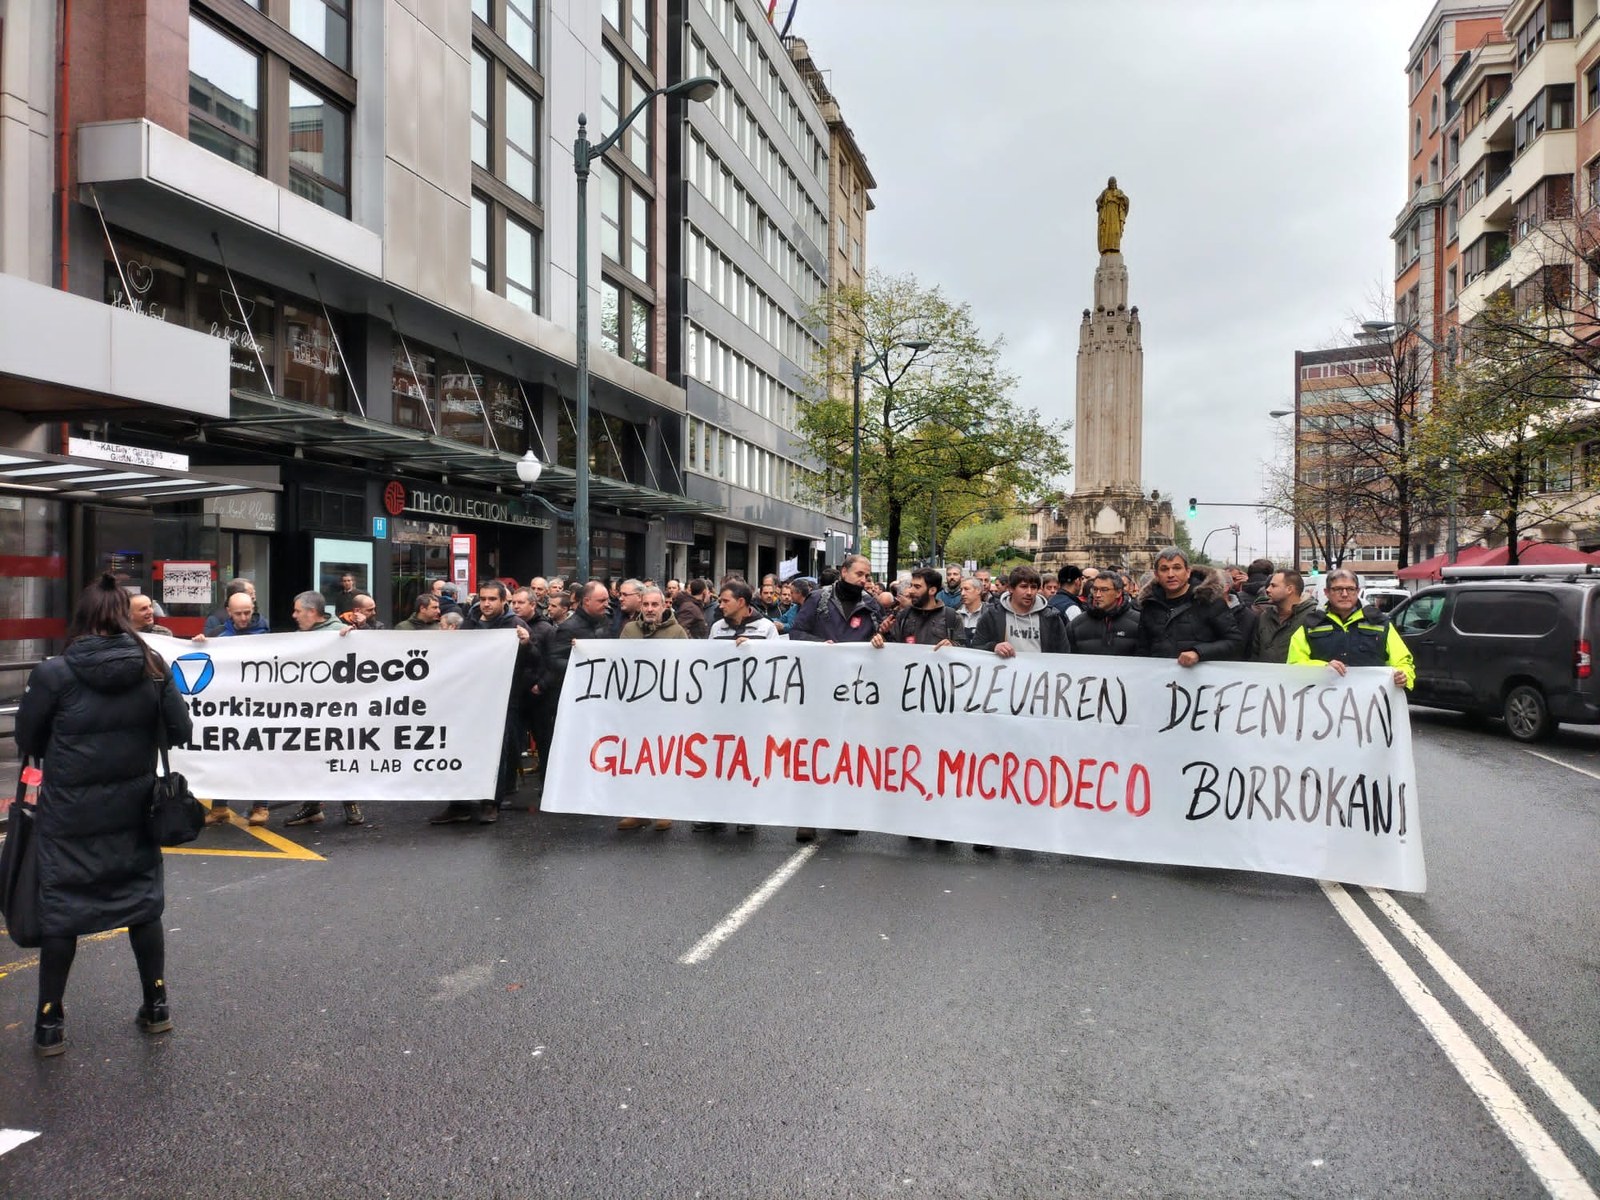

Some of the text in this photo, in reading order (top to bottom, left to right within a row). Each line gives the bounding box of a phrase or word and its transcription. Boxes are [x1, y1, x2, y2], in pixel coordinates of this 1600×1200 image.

[433, 494, 508, 521] COLLECTION
[186, 696, 427, 718] torkizunaren alde
[575, 656, 805, 705] INDUSTRIA
[833, 664, 880, 705] eta
[1158, 681, 1393, 748] DEFENTSAN
[168, 725, 447, 751] LERATZERIK EZ!
[328, 757, 463, 773] ELA LAB CCOO
[589, 732, 760, 788] GLAVISTA,
[763, 734, 934, 801] MECANER,
[937, 749, 1151, 818] MICRODECO
